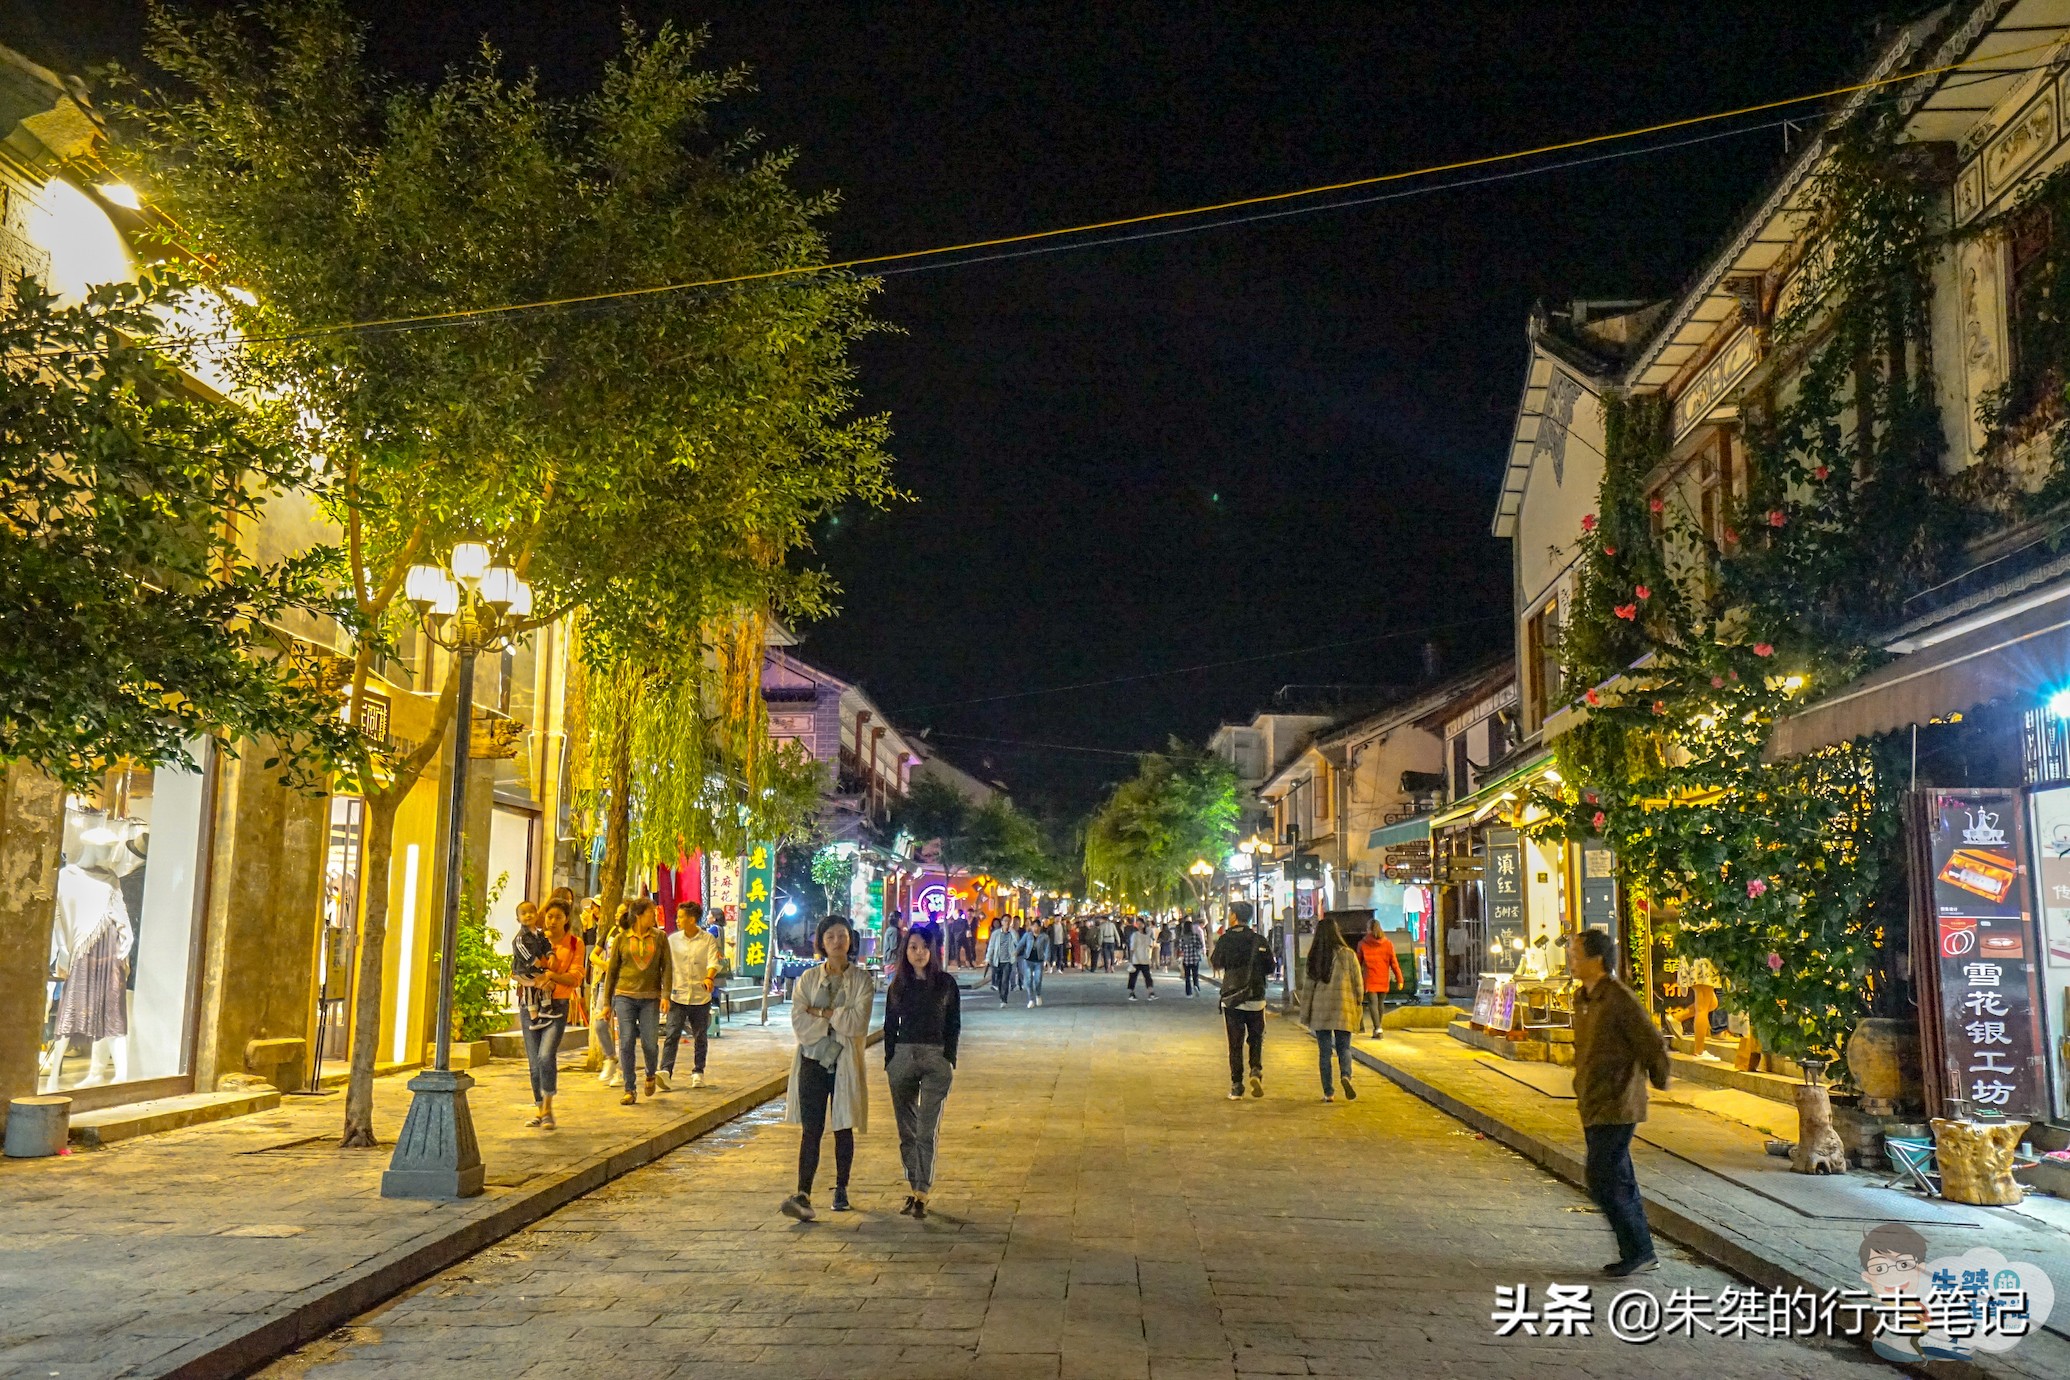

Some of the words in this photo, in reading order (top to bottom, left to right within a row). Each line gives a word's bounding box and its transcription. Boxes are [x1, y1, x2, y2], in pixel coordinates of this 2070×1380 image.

[745, 846, 769, 967] 老兵茶莊
[1963, 962, 2016, 1105] 雪花银工坊
